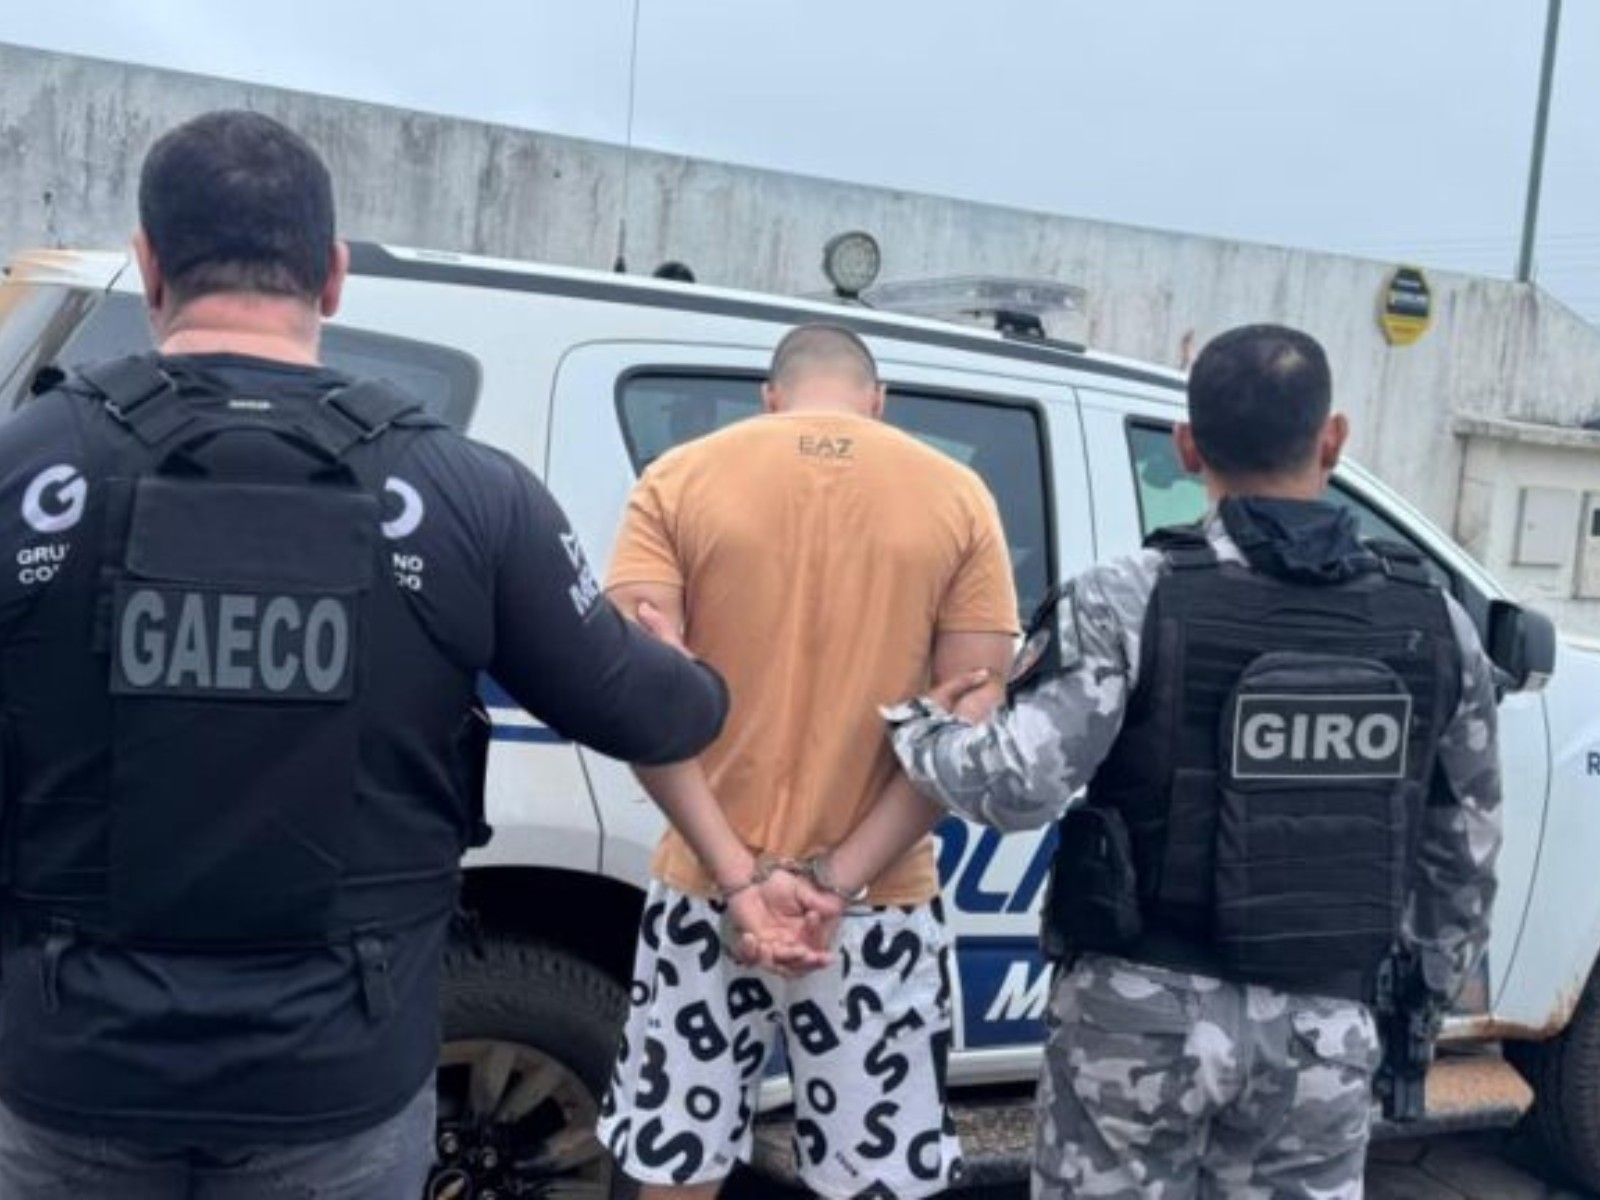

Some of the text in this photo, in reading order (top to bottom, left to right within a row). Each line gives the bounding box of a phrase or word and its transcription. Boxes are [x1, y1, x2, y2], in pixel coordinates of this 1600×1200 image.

[17, 544, 70, 565] GRU
[120, 590, 349, 693] GAECO
[1242, 713, 1400, 760] GIRO
